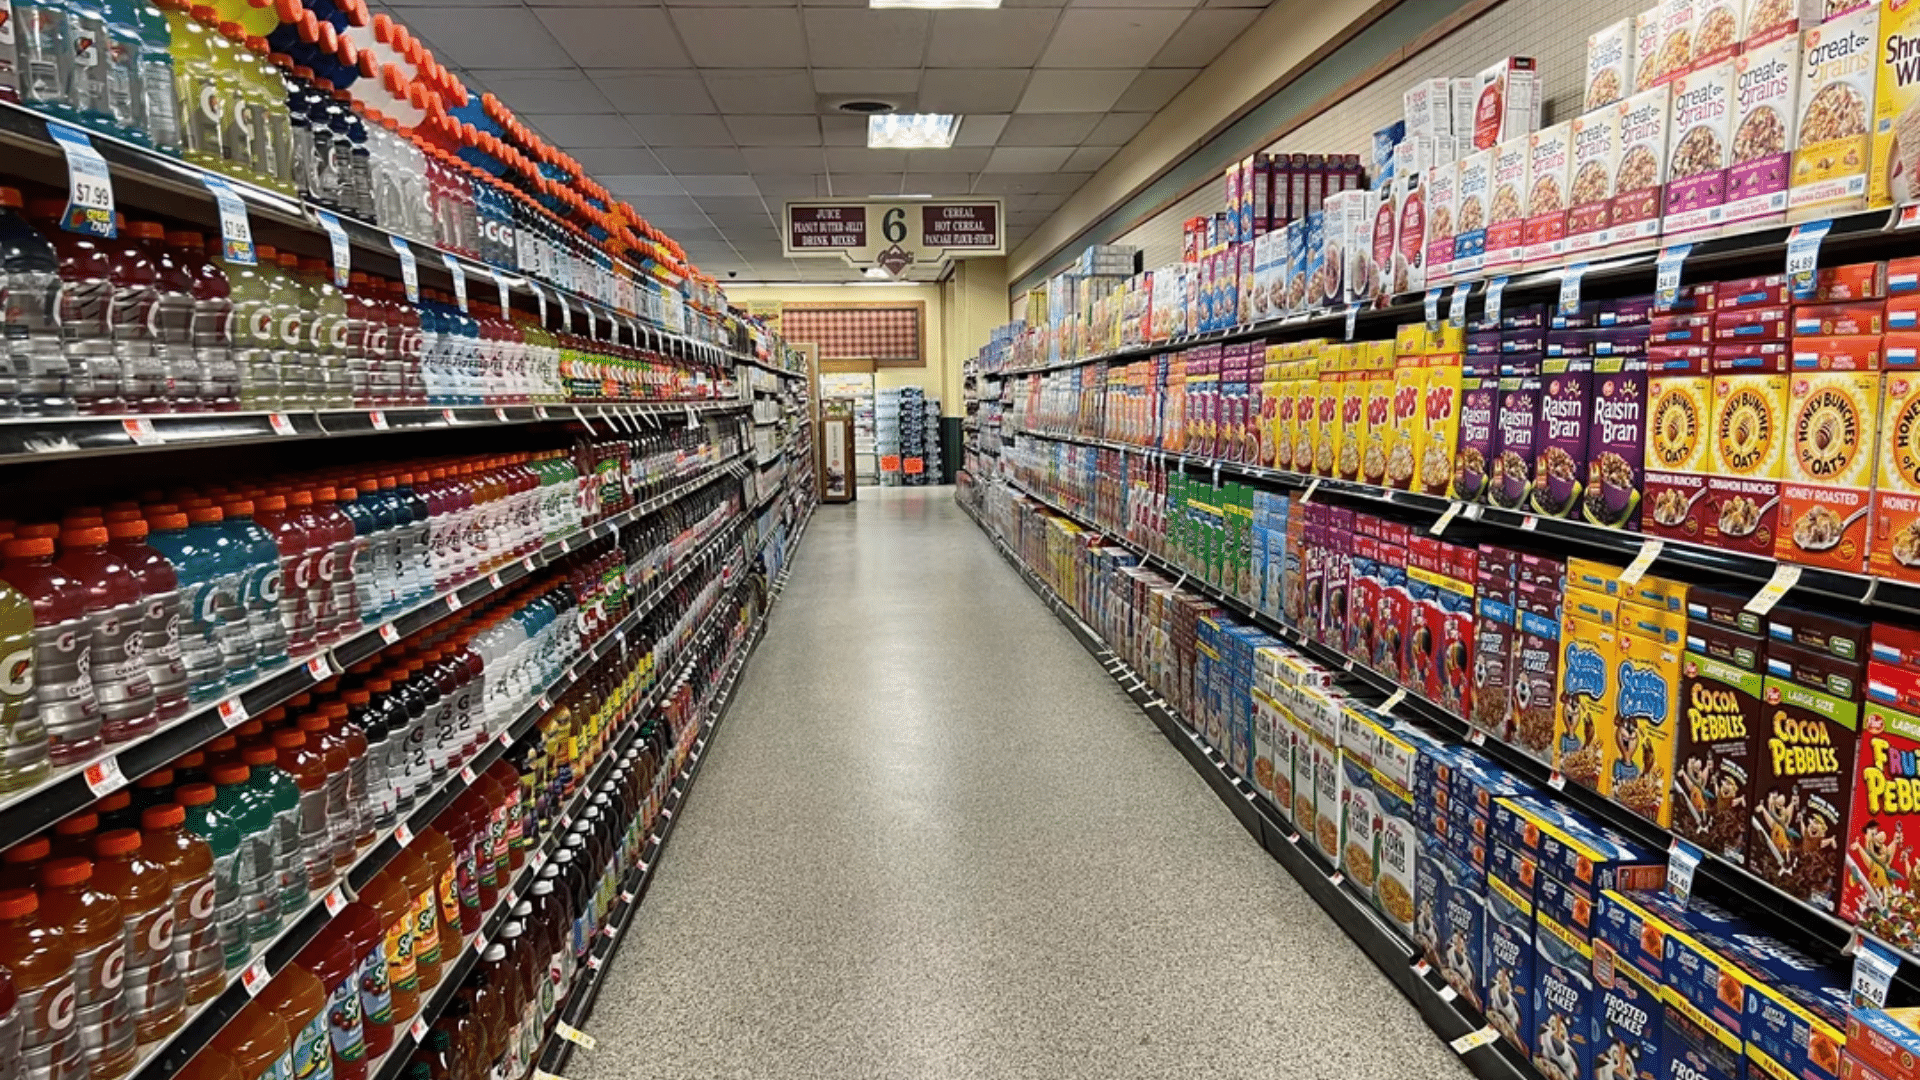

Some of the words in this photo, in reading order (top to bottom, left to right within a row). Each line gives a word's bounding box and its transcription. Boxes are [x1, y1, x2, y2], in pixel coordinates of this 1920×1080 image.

[1808, 30, 1856, 78] great
[1738, 58, 1776, 101] great
[1811, 50, 1869, 92] grains
[1676, 81, 1713, 121] great
[1740, 76, 1788, 114] grains
[1621, 103, 1652, 139] great
[1679, 99, 1725, 132] grains
[1575, 123, 1605, 155] great
[1622, 120, 1661, 151] grains
[76, 183, 109, 206] $7.99
[816, 209, 842, 219] JUICE
[943, 207, 975, 218] CEREAL
[225, 220, 246, 239] $7.99
[499, 225, 514, 247] G
[794, 221, 818, 233] PEANUT
[883, 207, 907, 243] 6
[935, 221, 951, 231] HOT
[952, 220, 985, 231] CEREAL
[802, 235, 829, 246] DRINK
[831, 235, 857, 246] MIXES
[925, 233, 952, 244] PANCAKE
[1461, 406, 1490, 427] Raisin
[1498, 406, 1533, 430] Raisin
[1541, 395, 1581, 421] Raisin
[1594, 396, 1639, 424] Raisin
[1656, 397, 1670, 436] HONEY
[1672, 392, 1695, 437] BUNCHES
[1722, 396, 1741, 439] HONEY
[1742, 392, 1768, 441] BUNCHES
[1799, 395, 1822, 442] HONEY
[1824, 392, 1855, 446] BUNCHES
[1466, 423, 1489, 441] Bran
[1504, 425, 1531, 445] Bran
[1548, 417, 1580, 439] Bran
[1602, 420, 1637, 443] Bran
[1665, 443, 1689, 463] OATS
[1732, 447, 1760, 468] OATS
[1811, 452, 1846, 475] OATS
[1742, 481, 1776, 495] BUNCHES
[1785, 486, 1814, 500] HONEY
[1815, 488, 1859, 506] ROASTED
[1882, 495, 1917, 512] HONEY
[149, 602, 164, 618] G
[101, 617, 120, 636] G
[57, 631, 76, 652] G
[1523, 649, 1549, 661] FROSTED
[1523, 659, 1546, 672] FLAKES
[0, 651, 33, 695] G
[1691, 682, 1739, 713] COCOA
[1788, 690, 1814, 706] LARGE
[1815, 697, 1835, 713] SIZE
[459, 715, 470, 731] 2
[1687, 708, 1747, 743] PEBBLES
[1773, 710, 1831, 746] COCOA
[1768, 738, 1839, 776] PEBBLES
[1385, 829, 1405, 853] CORN
[1385, 847, 1405, 873] FLAKES
[1493, 932, 1520, 956] FROSTED
[1493, 944, 1516, 966] FLAKES
[1543, 974, 1578, 1001] FROSTED
[1544, 986, 1574, 1012] FLAKES
[1857, 978, 1883, 1003] $5.49
[1603, 992, 1648, 1024] FROSTED
[1605, 1006, 1642, 1037] FLAKES
